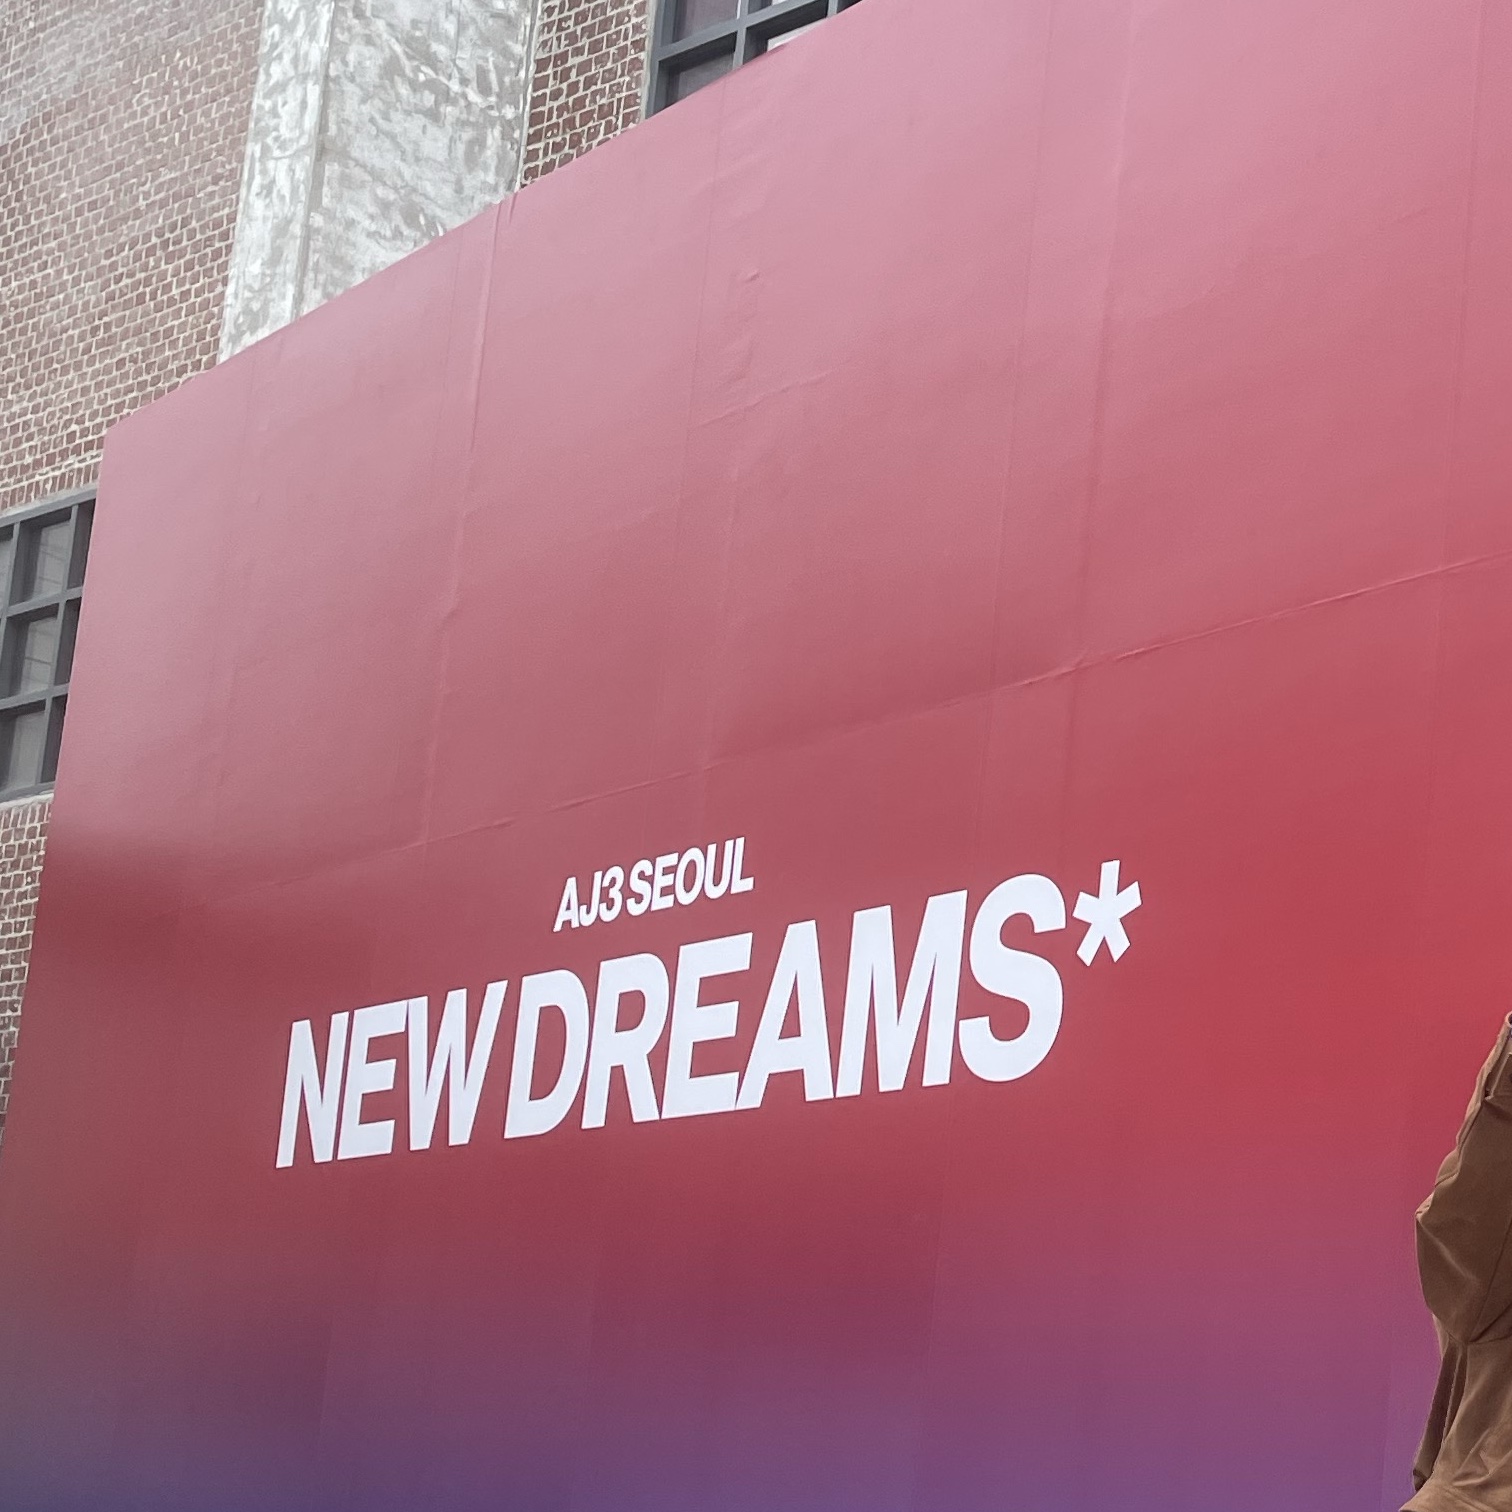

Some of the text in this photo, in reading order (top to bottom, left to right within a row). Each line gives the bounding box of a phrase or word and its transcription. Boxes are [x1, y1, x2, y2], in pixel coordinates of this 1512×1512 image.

[553, 837, 755, 932] AJ3 SEOUL
[276, 979, 509, 1169] NEW
